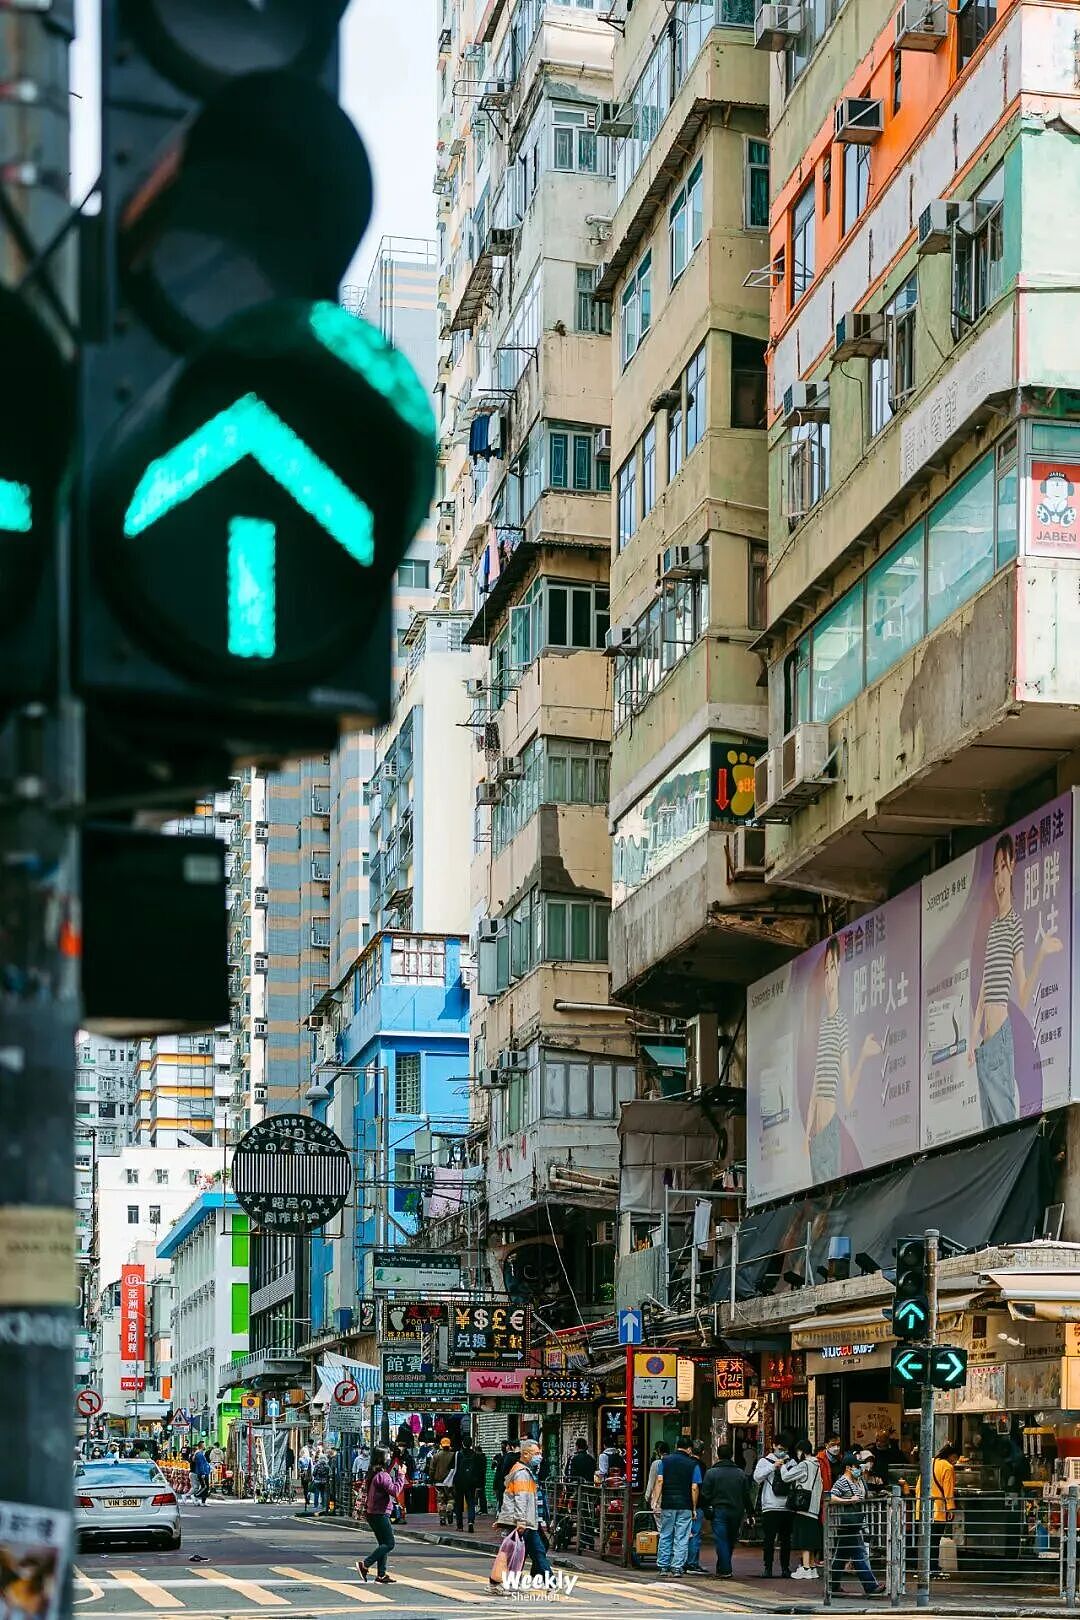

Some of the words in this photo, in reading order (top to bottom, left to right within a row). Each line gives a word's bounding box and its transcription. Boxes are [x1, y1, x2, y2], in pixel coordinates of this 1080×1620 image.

[1036, 531, 1077, 542] JABEN
[1023, 850, 1061, 911] 肥胖
[1034, 903, 1058, 944] 人士
[727, 1374, 742, 1382] 2/F
[542, 1381, 578, 1389] CHANGE
[661, 1380, 668, 1390] 7
[661, 1395, 674, 1406] 12
